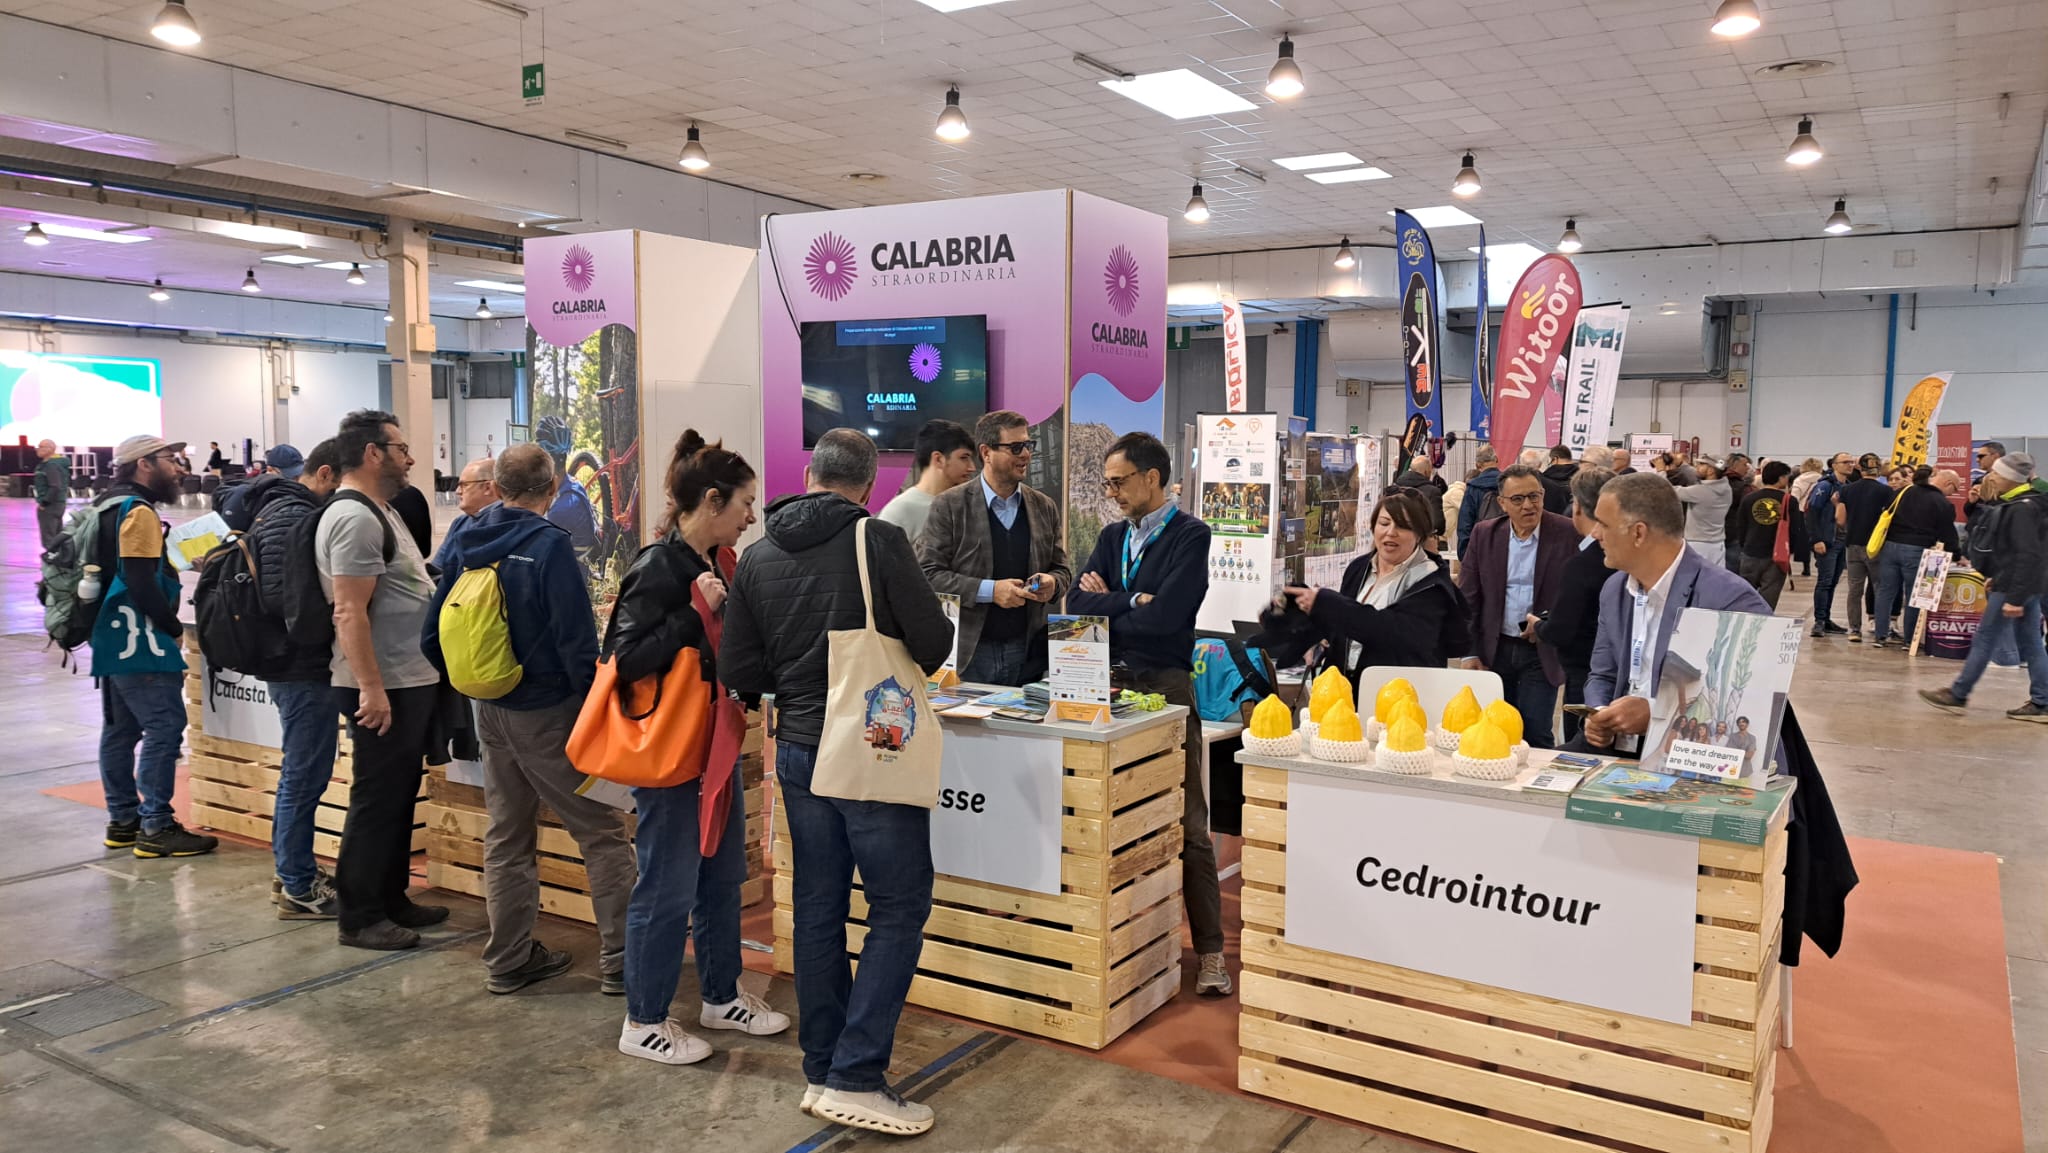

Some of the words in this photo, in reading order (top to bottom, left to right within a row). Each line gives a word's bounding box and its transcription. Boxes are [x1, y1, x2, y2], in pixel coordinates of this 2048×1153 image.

[871, 233, 1015, 271] CALABRIA
[872, 267, 1016, 287] STRAORDINARIA
[552, 299, 606, 315] CALABRIA
[1092, 322, 1148, 349] CALABRIA
[1500, 272, 1575, 399] Witoor
[867, 393, 916, 404] CALABRIA
[1576, 358, 1596, 416] TRAIL
[1571, 423, 1587, 452] ISE
[215, 680, 266, 704] Catasta
[1673, 744, 1689, 754] love
[1691, 747, 1707, 757] and
[1708, 750, 1739, 761] dreams
[1684, 758, 1697, 767] the
[1699, 762, 1716, 772] way
[936, 788, 986, 814] sse
[1356, 856, 1601, 926] Cedrointour
